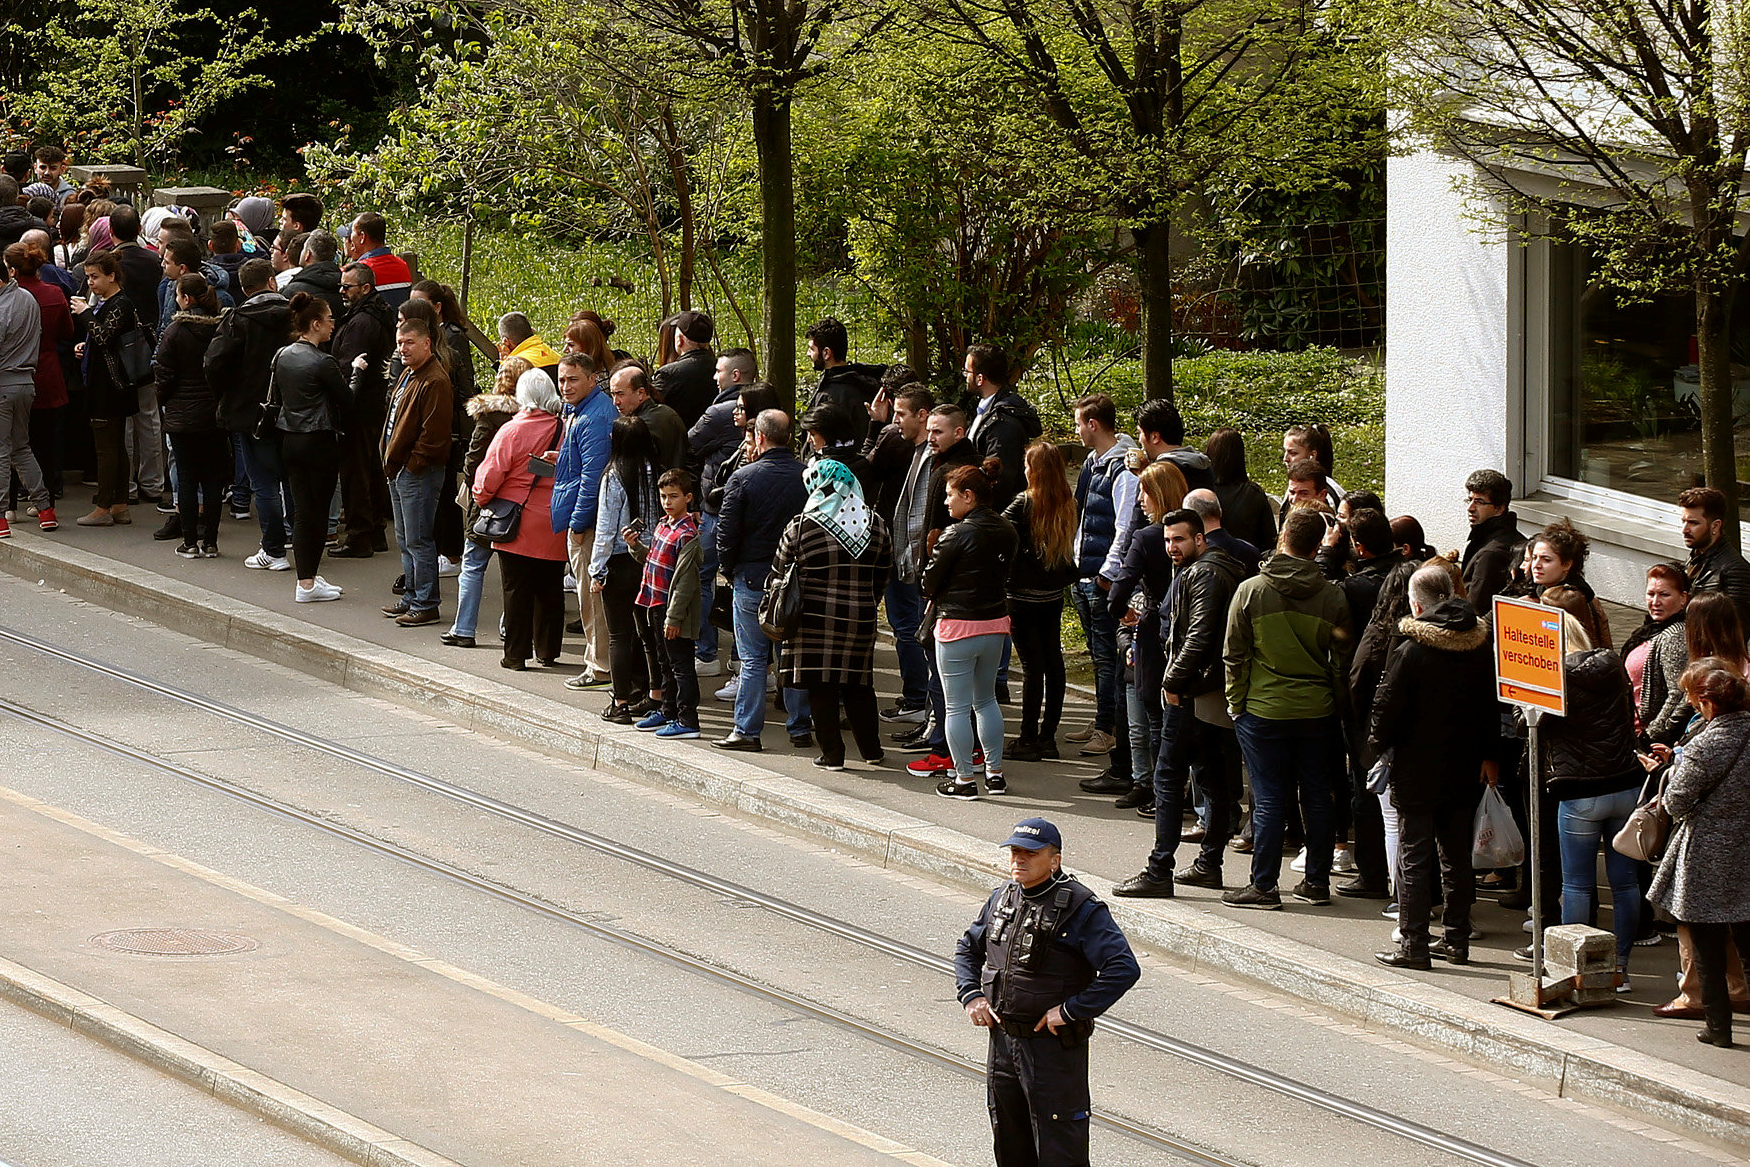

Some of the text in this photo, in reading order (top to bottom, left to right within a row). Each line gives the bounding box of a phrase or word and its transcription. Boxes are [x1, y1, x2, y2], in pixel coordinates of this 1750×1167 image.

[1503, 625, 1555, 650] Haltestelle
[1502, 649, 1559, 672] verschoben
[1012, 825, 1041, 836] Polizei
